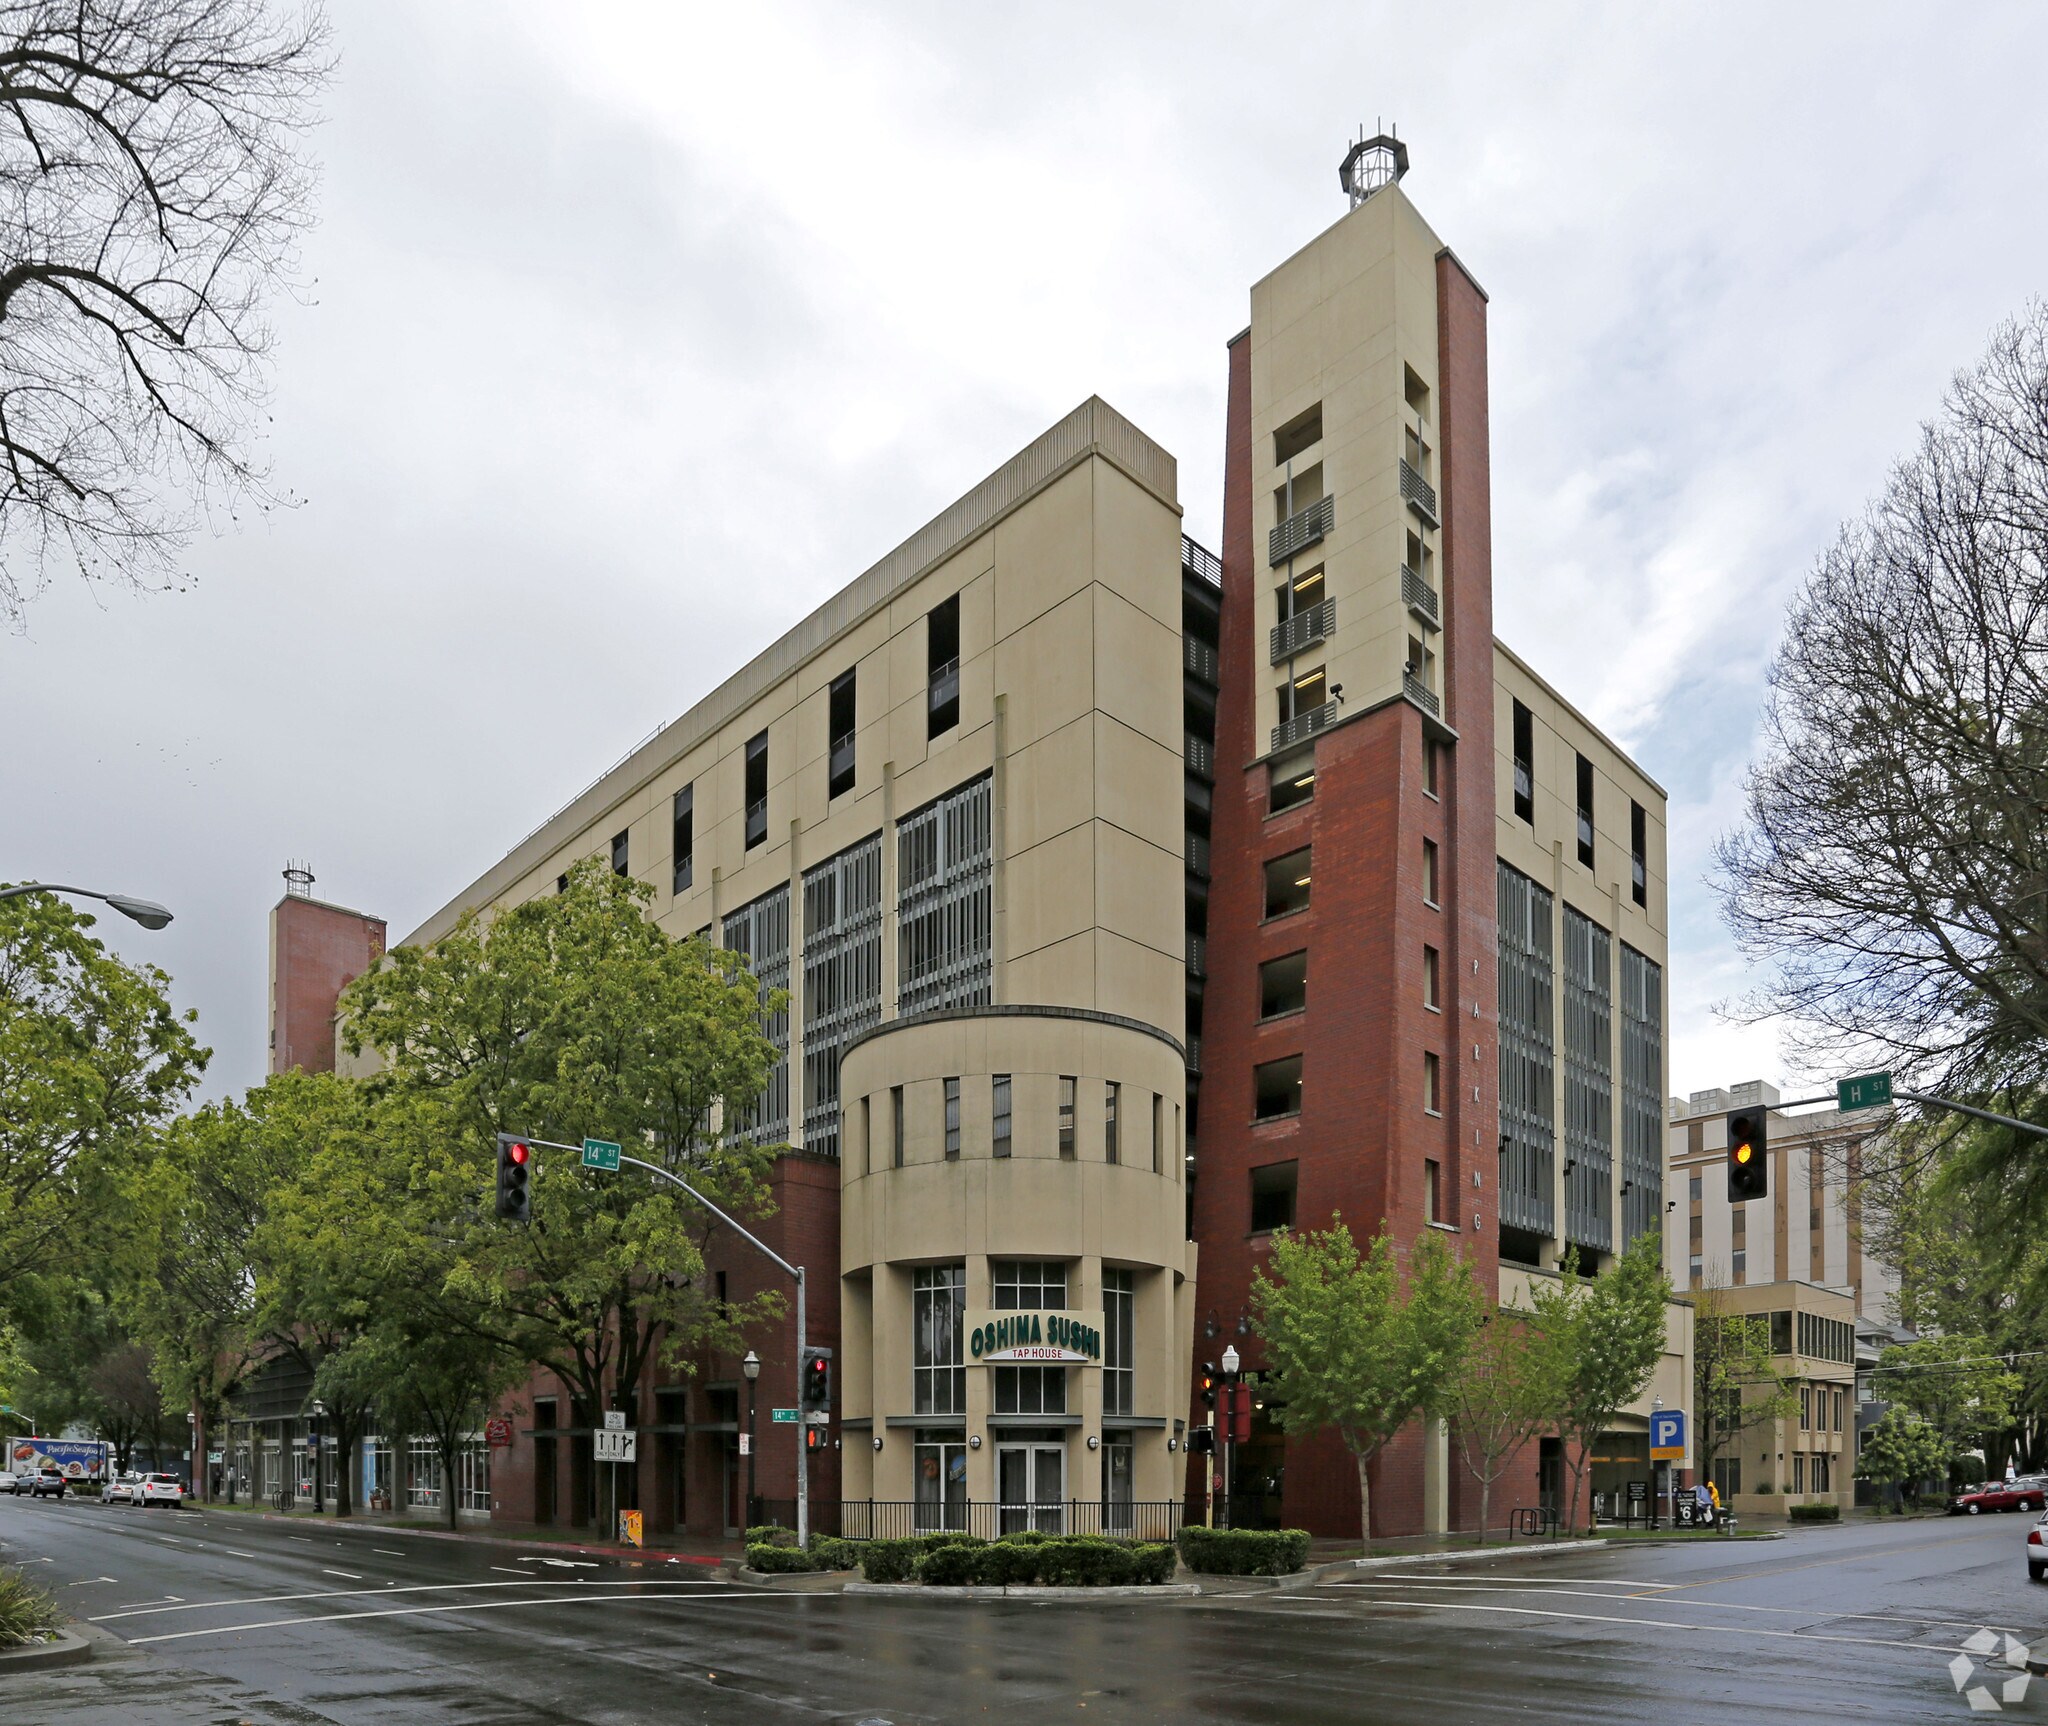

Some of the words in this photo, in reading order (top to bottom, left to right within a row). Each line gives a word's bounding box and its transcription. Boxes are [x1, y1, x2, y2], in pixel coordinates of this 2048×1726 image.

[1473, 959, 1481, 1230] PARKING
[1851, 1085, 1861, 1103] H
[1873, 1080, 1884, 1091] ST
[607, 1149, 616, 1158] ST
[971, 1314, 1042, 1358] OSHIMA
[1047, 1315, 1101, 1360] SUSHI
[1012, 1349, 1030, 1359] TAP
[1032, 1348, 1063, 1359] HOUSE
[1658, 1420, 1678, 1446] P
